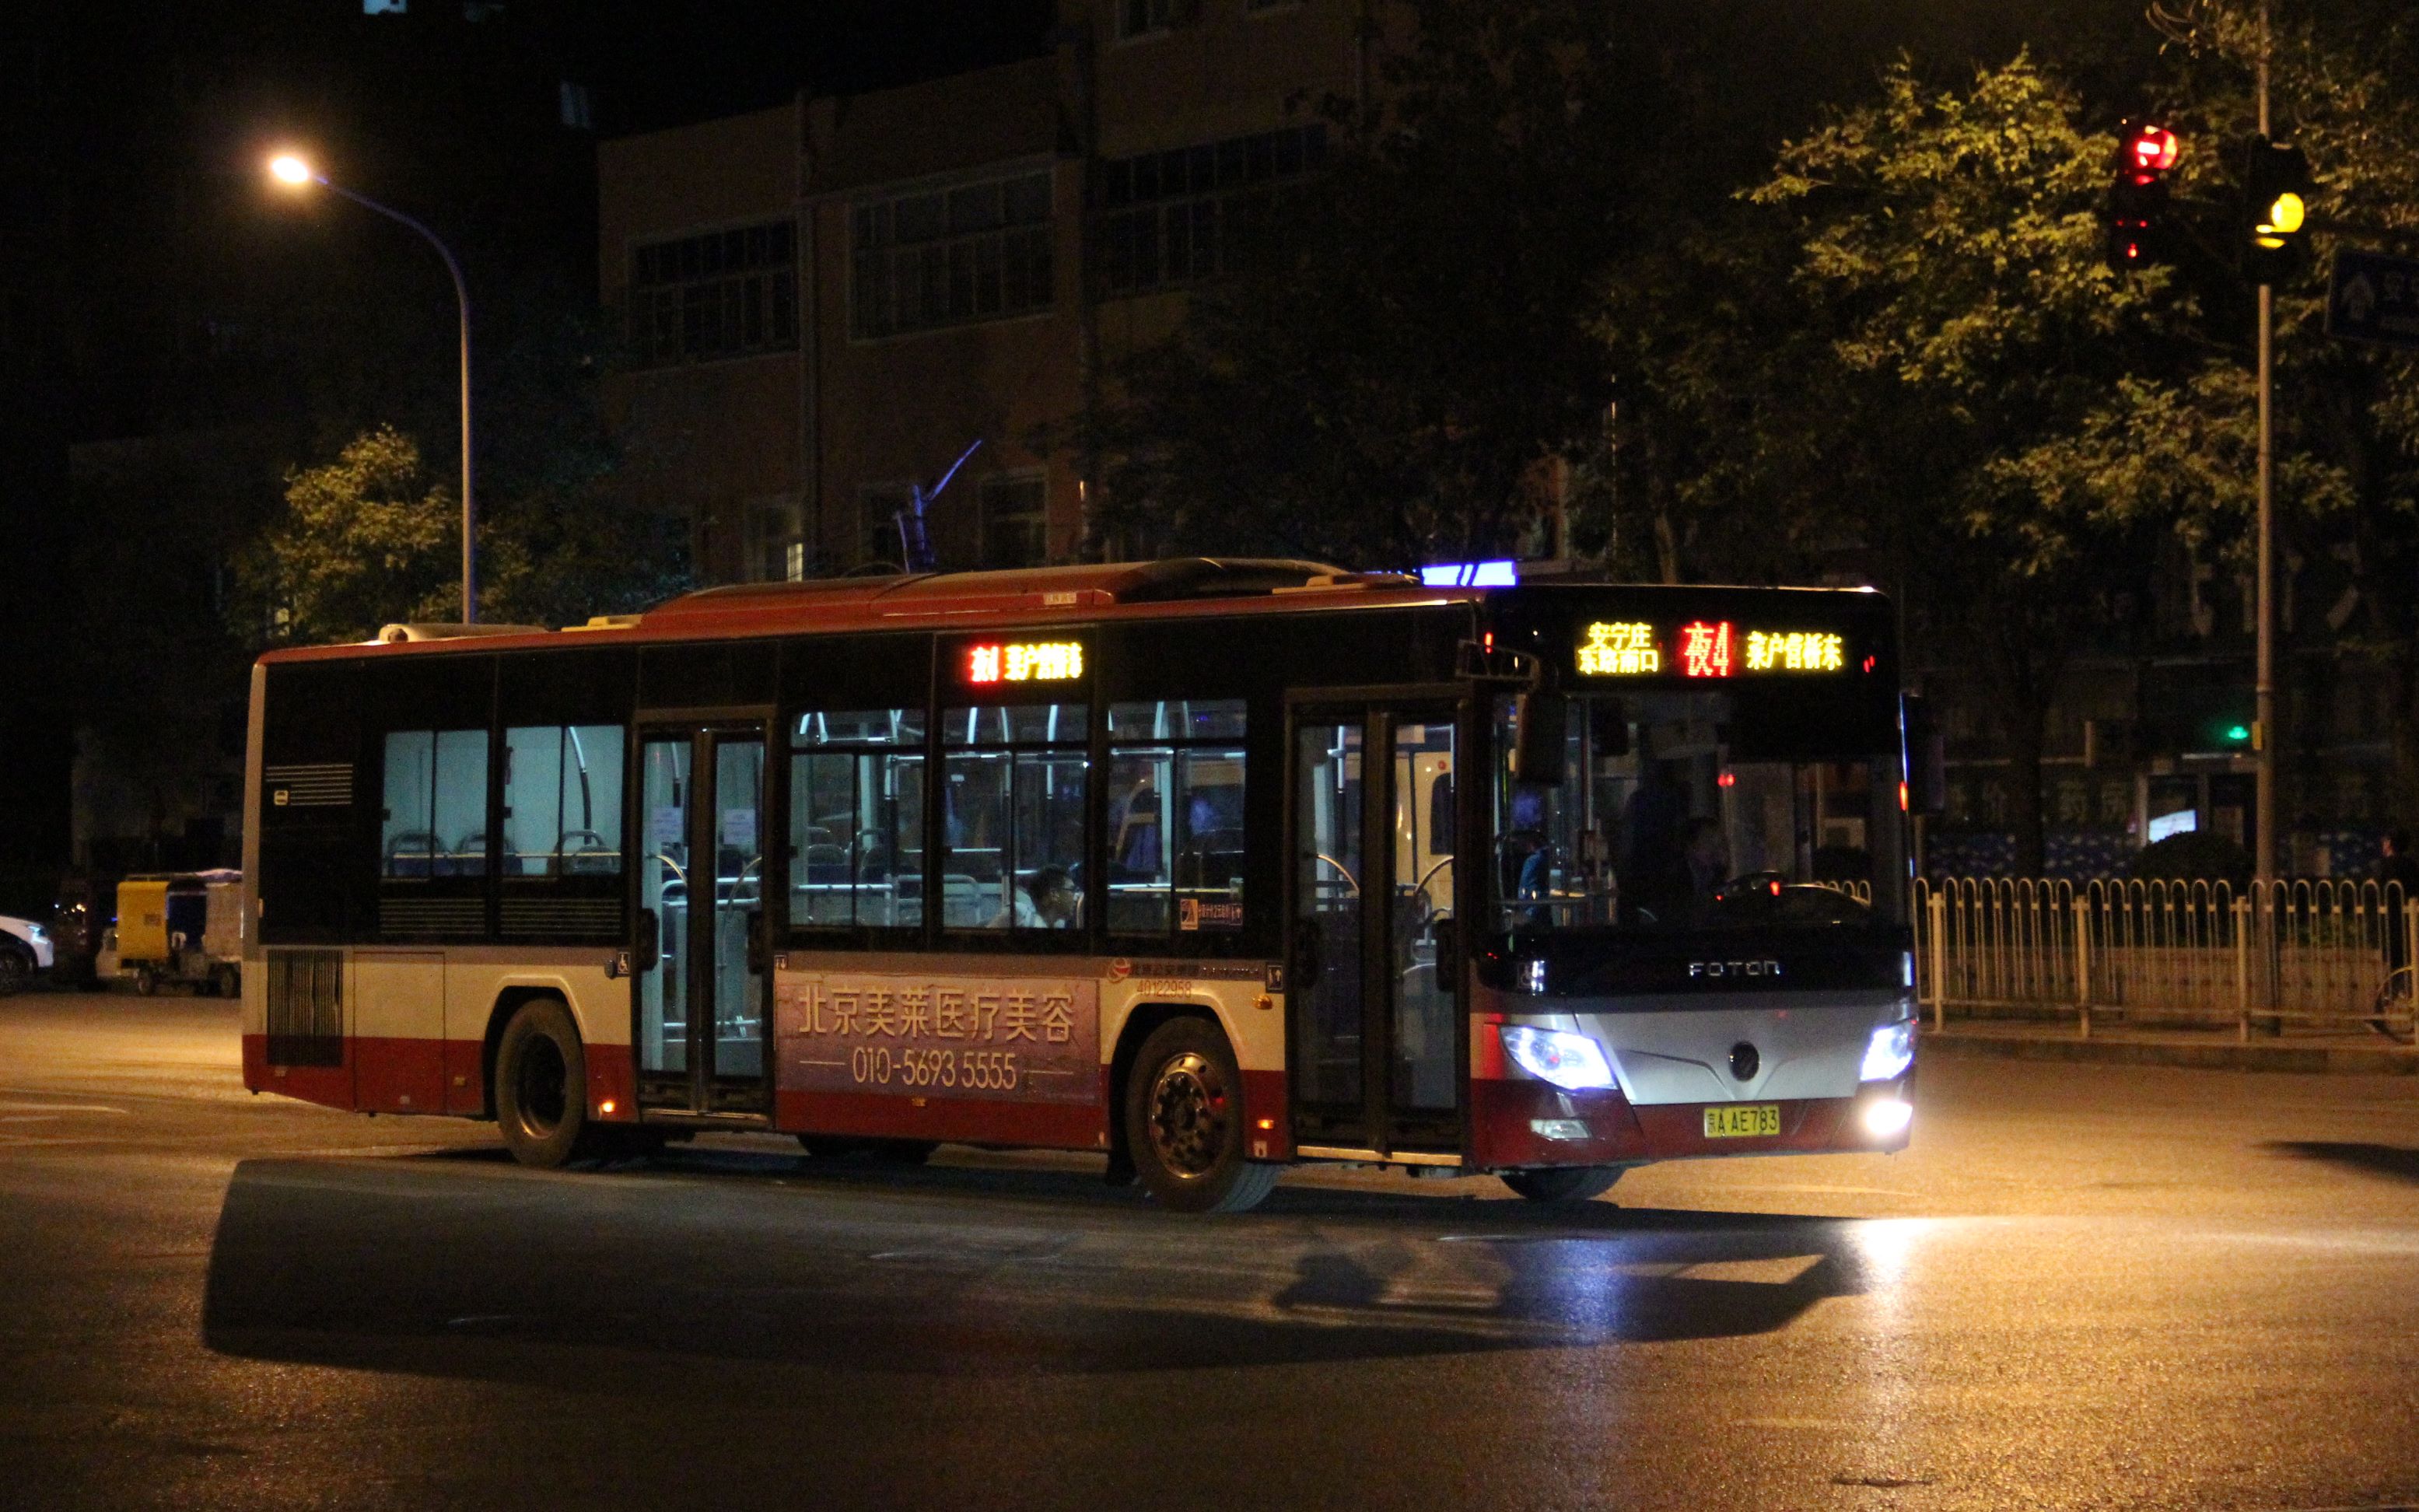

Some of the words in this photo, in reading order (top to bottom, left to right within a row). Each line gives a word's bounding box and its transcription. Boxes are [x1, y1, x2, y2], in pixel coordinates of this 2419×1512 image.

[1588, 621, 1652, 649] 安宁庄
[1684, 621, 1729, 677] 夜4
[1578, 647, 1658, 674] 东路南口
[1689, 960, 1780, 976] FOTON
[798, 983, 1074, 1042] 北京美莱医疗美容
[852, 1047, 956, 1087] 010-5693
[961, 1052, 1017, 1090] 5555
